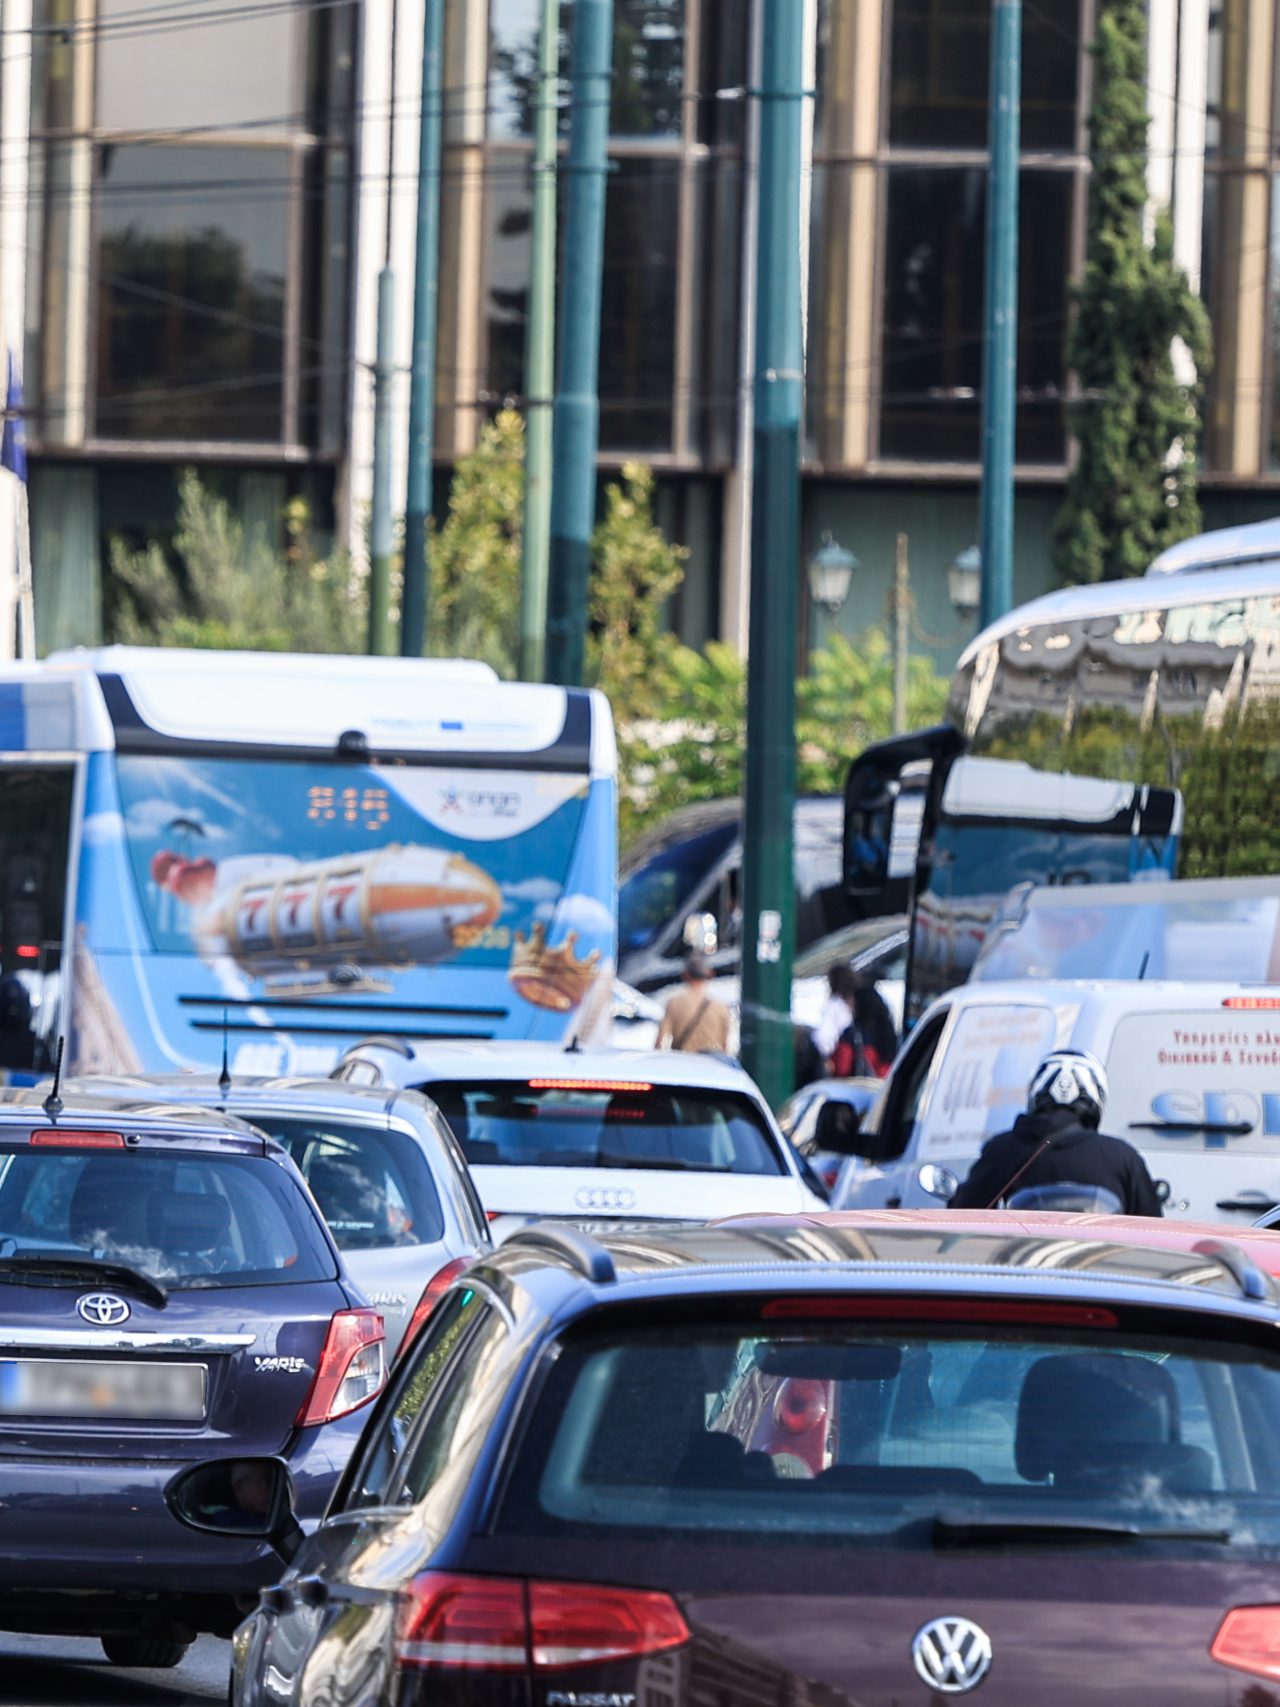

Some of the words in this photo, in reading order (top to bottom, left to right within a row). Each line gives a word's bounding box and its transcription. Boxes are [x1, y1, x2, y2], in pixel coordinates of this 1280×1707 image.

[241, 899, 266, 931] 7
[284, 893, 308, 927] 7
[329, 885, 356, 920] 7
[254, 1356, 306, 1373] YARIS
